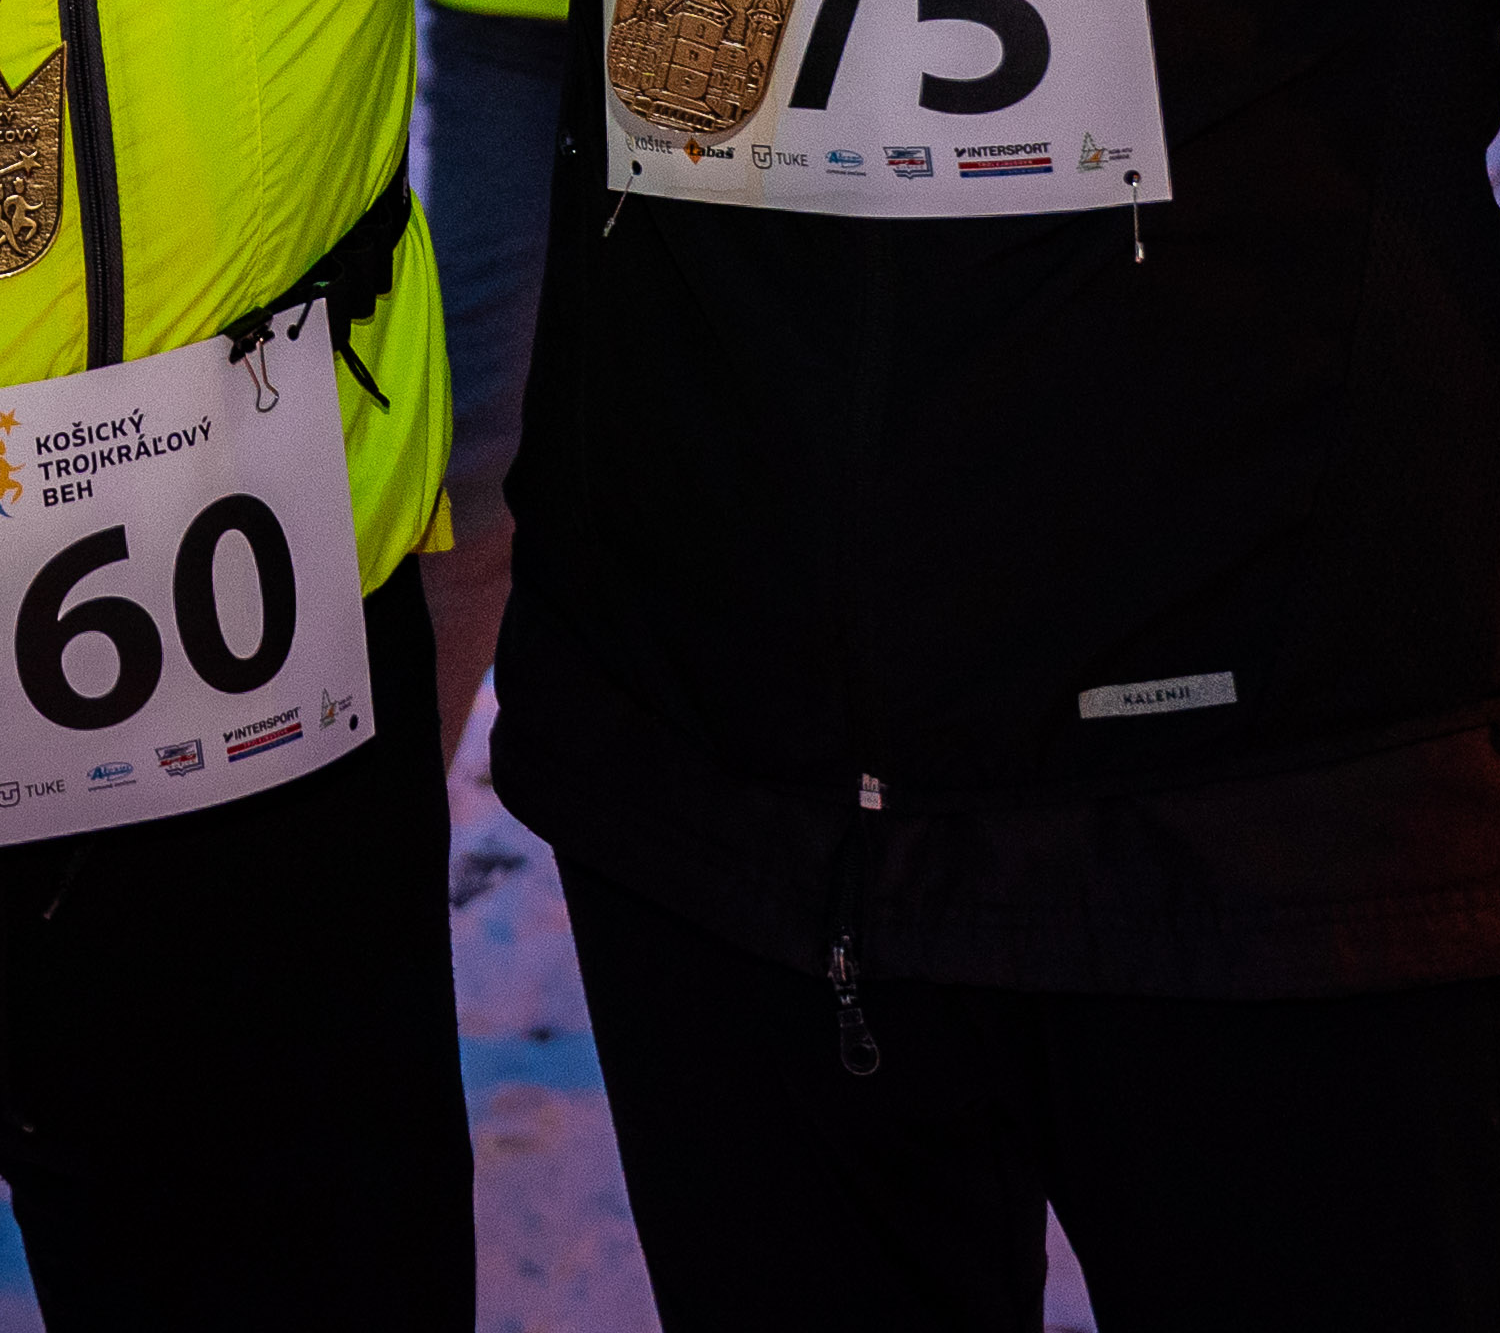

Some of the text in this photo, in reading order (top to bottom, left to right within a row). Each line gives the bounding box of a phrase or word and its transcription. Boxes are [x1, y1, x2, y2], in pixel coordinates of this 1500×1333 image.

[690, 144, 736, 160] Labaš
[775, 152, 809, 167] TUKE
[967, 142, 1051, 157] INTERSPORT
[35, 408, 144, 455] KOŠICKÝ
[37, 416, 212, 480] TROJKRÁĽOVÝ
[42, 479, 93, 507] BEH
[1123, 686, 1190, 705] KALENJI
[234, 706, 301, 740] INTERSPORT
[25, 779, 66, 799] TUKE
